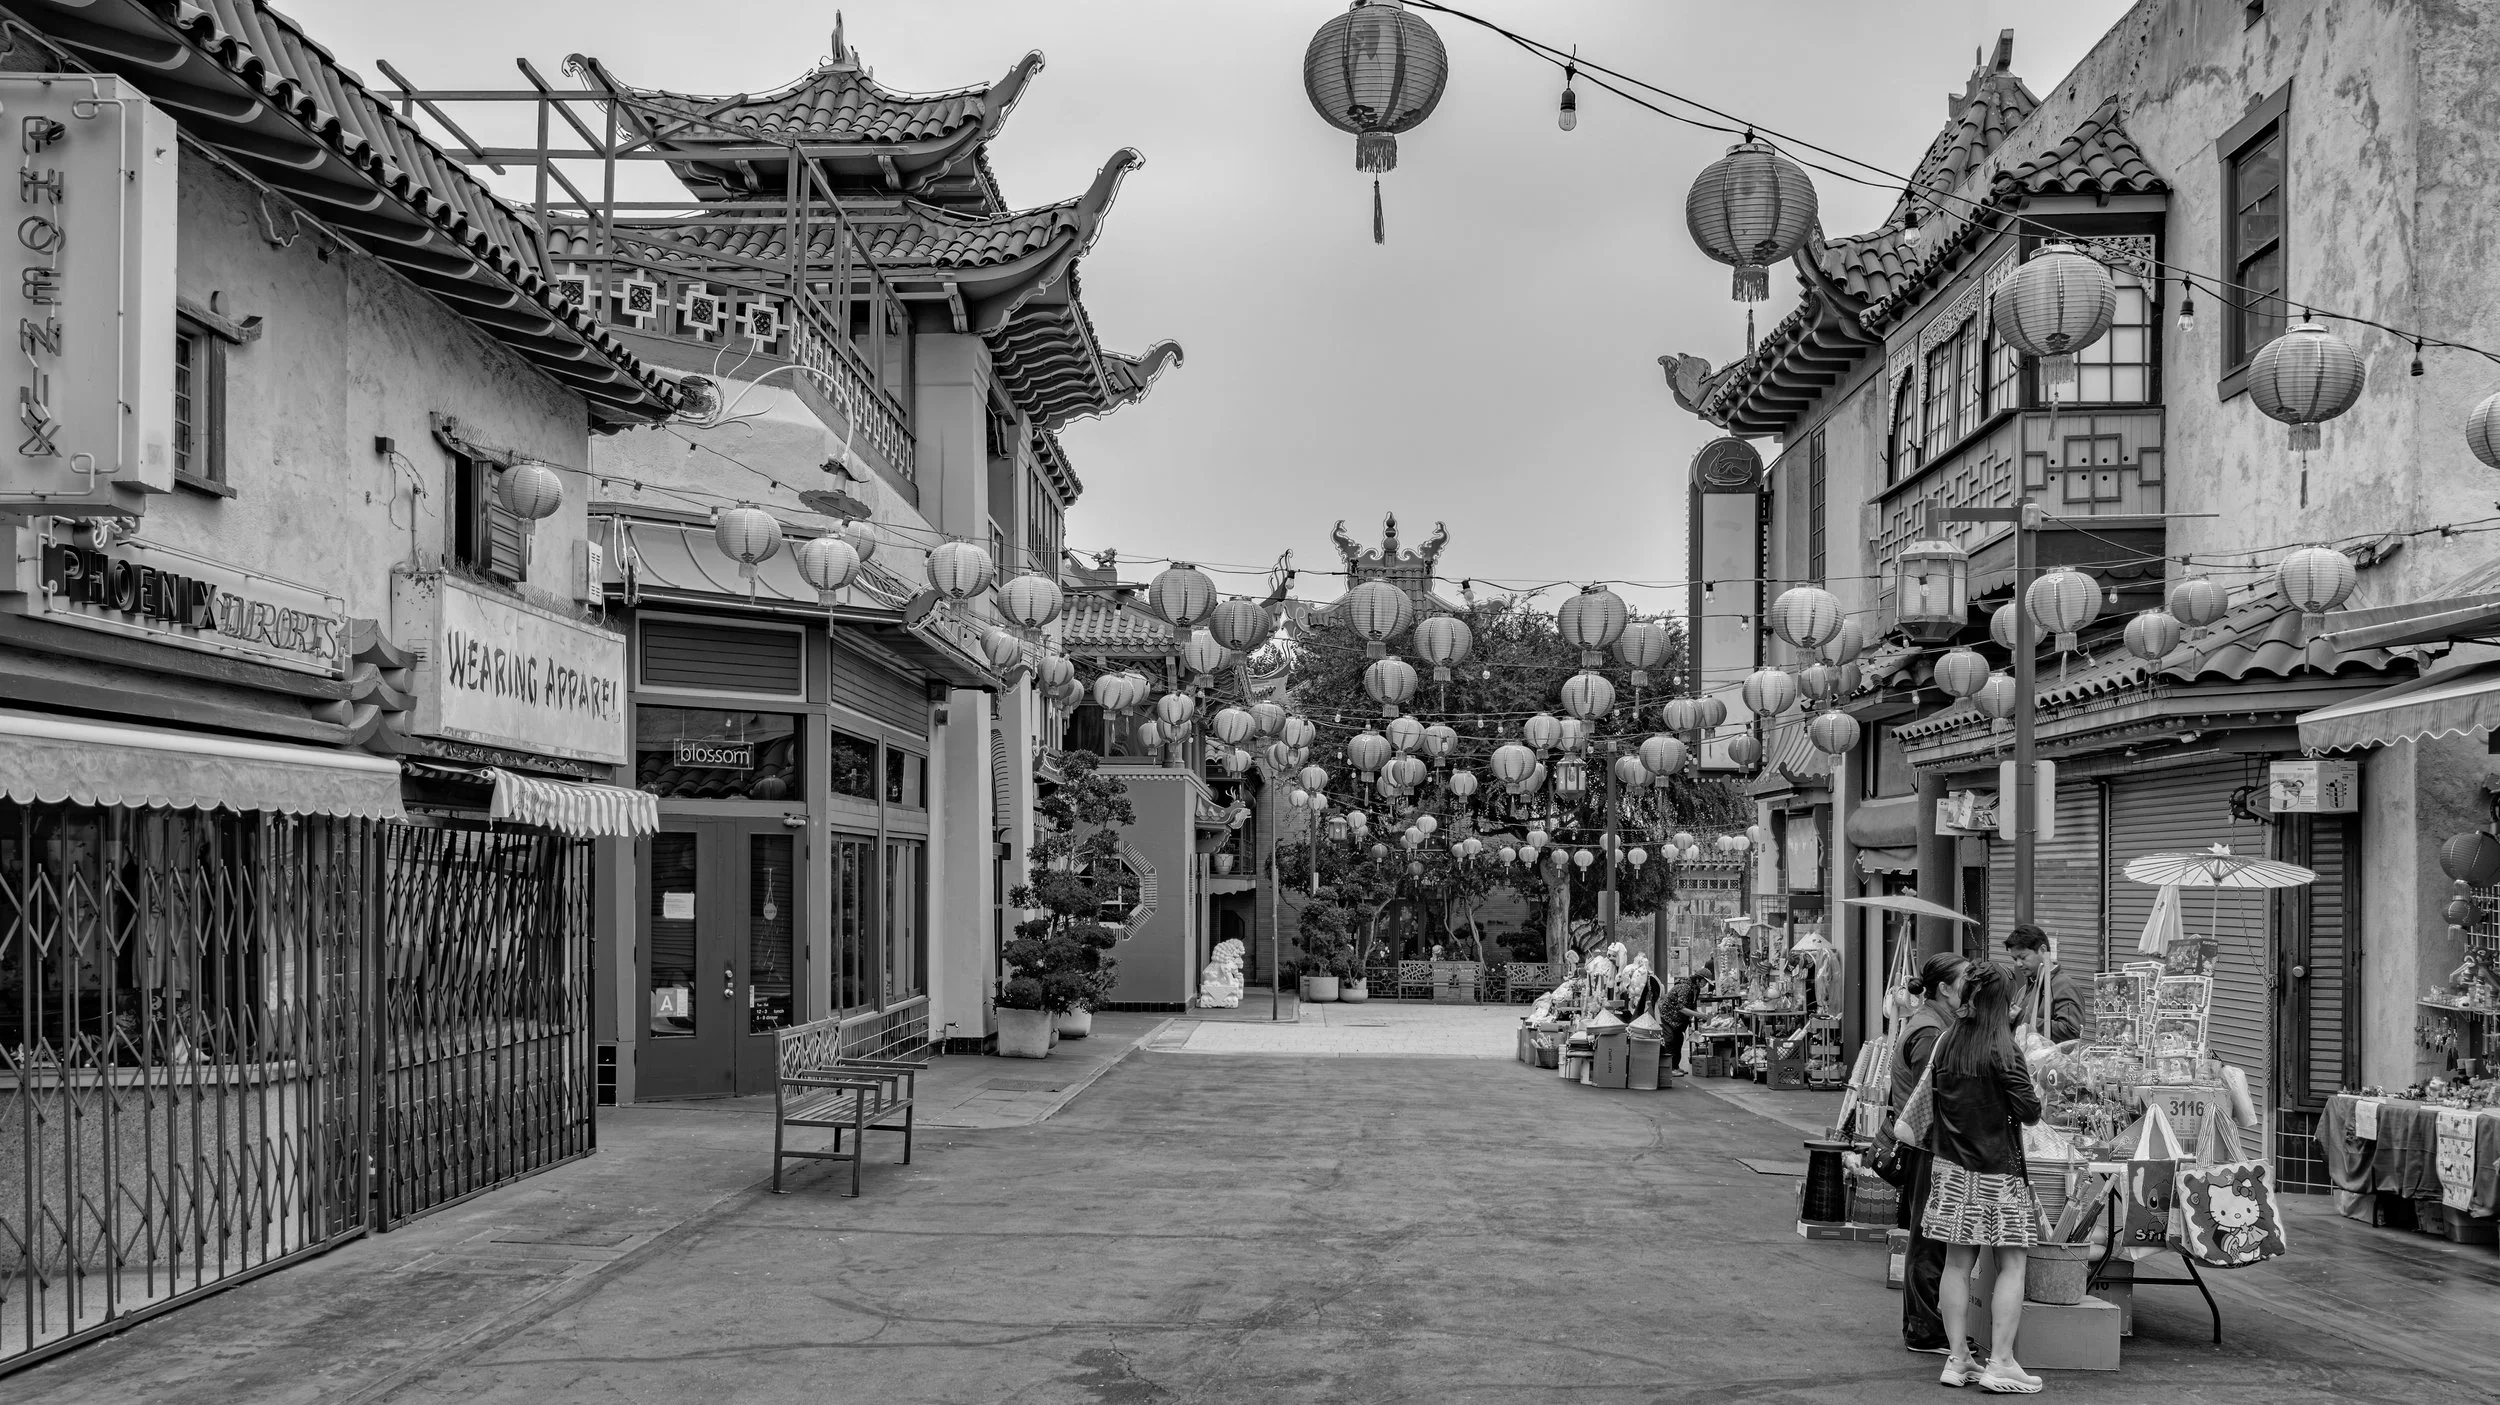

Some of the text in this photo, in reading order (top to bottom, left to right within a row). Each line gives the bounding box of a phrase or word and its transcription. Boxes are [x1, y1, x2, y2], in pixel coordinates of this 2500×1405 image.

[18, 115, 67, 458] PHOENIX
[43, 543, 338, 659] PHOENIX IMPORTS
[447, 626, 621, 724] WEARING APPAREL
[680, 742, 750, 765] blossom
[660, 995, 673, 1011] A
[2169, 1100, 2205, 1117] 3116
[2135, 1228, 2168, 1241] STI
